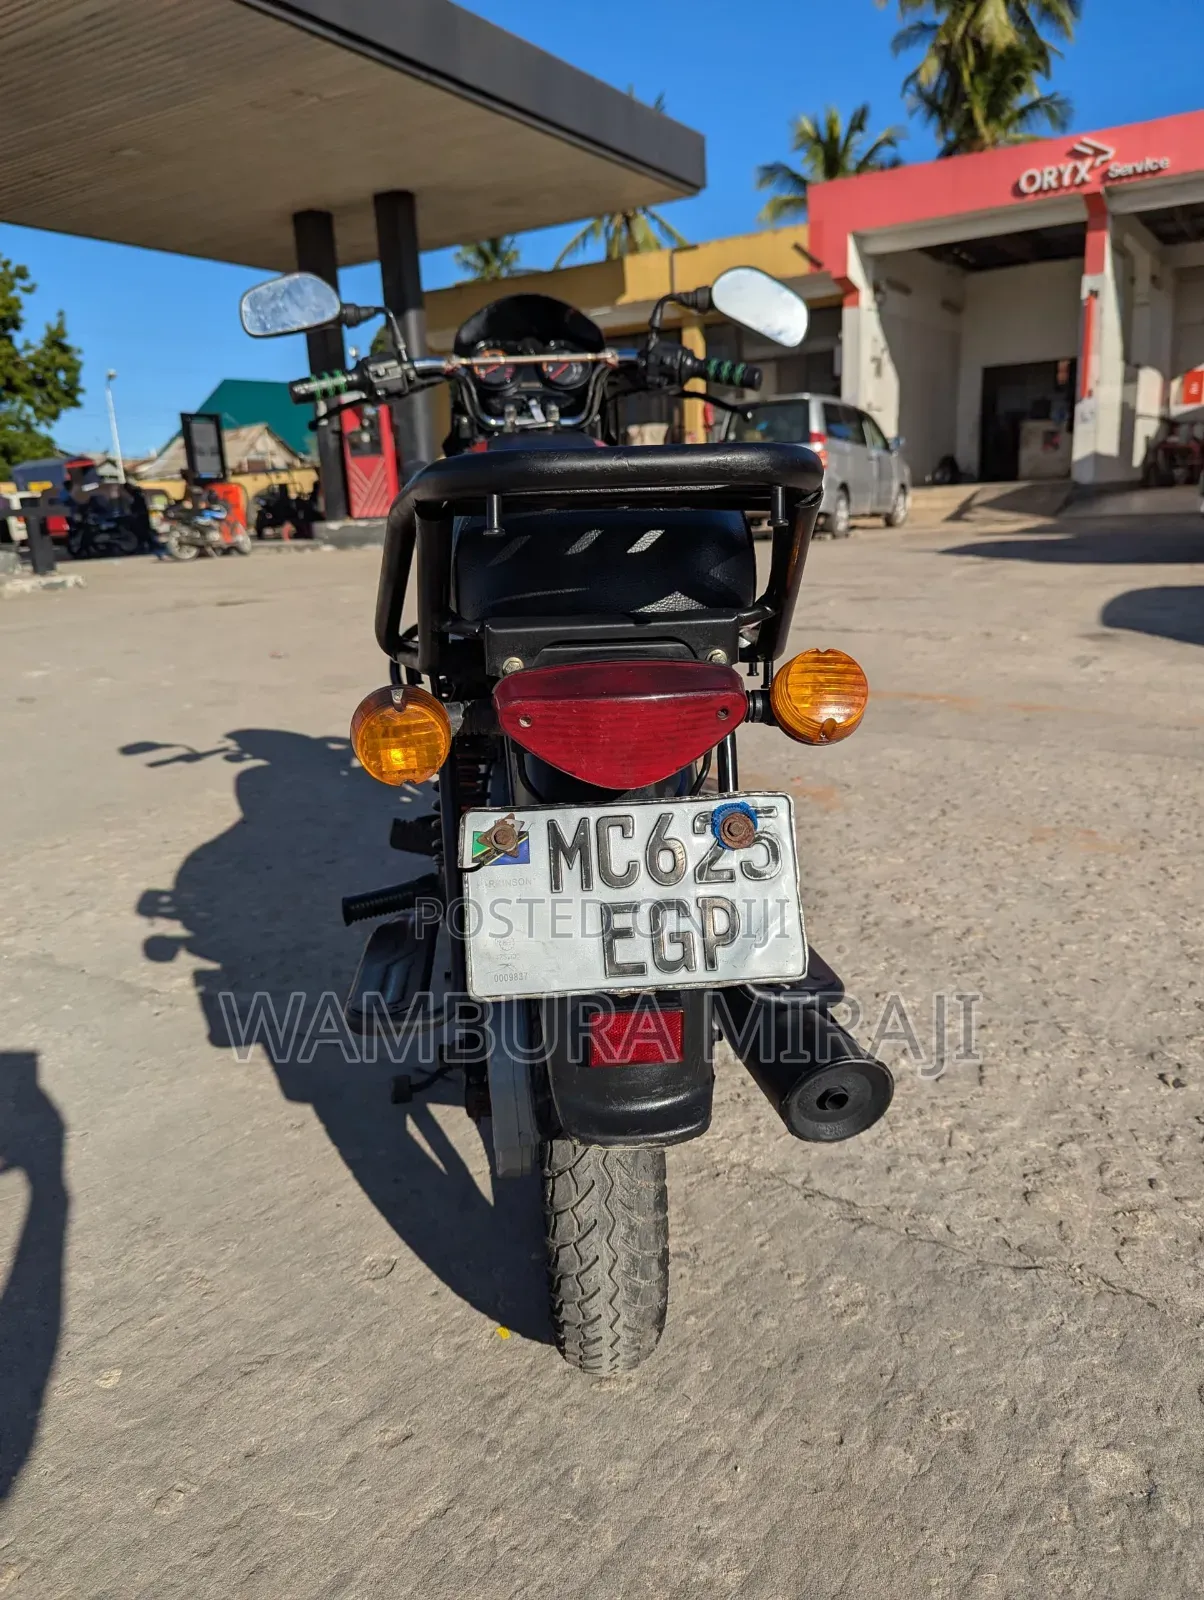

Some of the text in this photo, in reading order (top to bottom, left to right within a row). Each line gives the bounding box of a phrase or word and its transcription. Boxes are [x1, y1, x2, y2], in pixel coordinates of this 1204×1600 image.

[1018, 157, 1170, 194] ORYX Service
[601, 896, 741, 979] EGP
